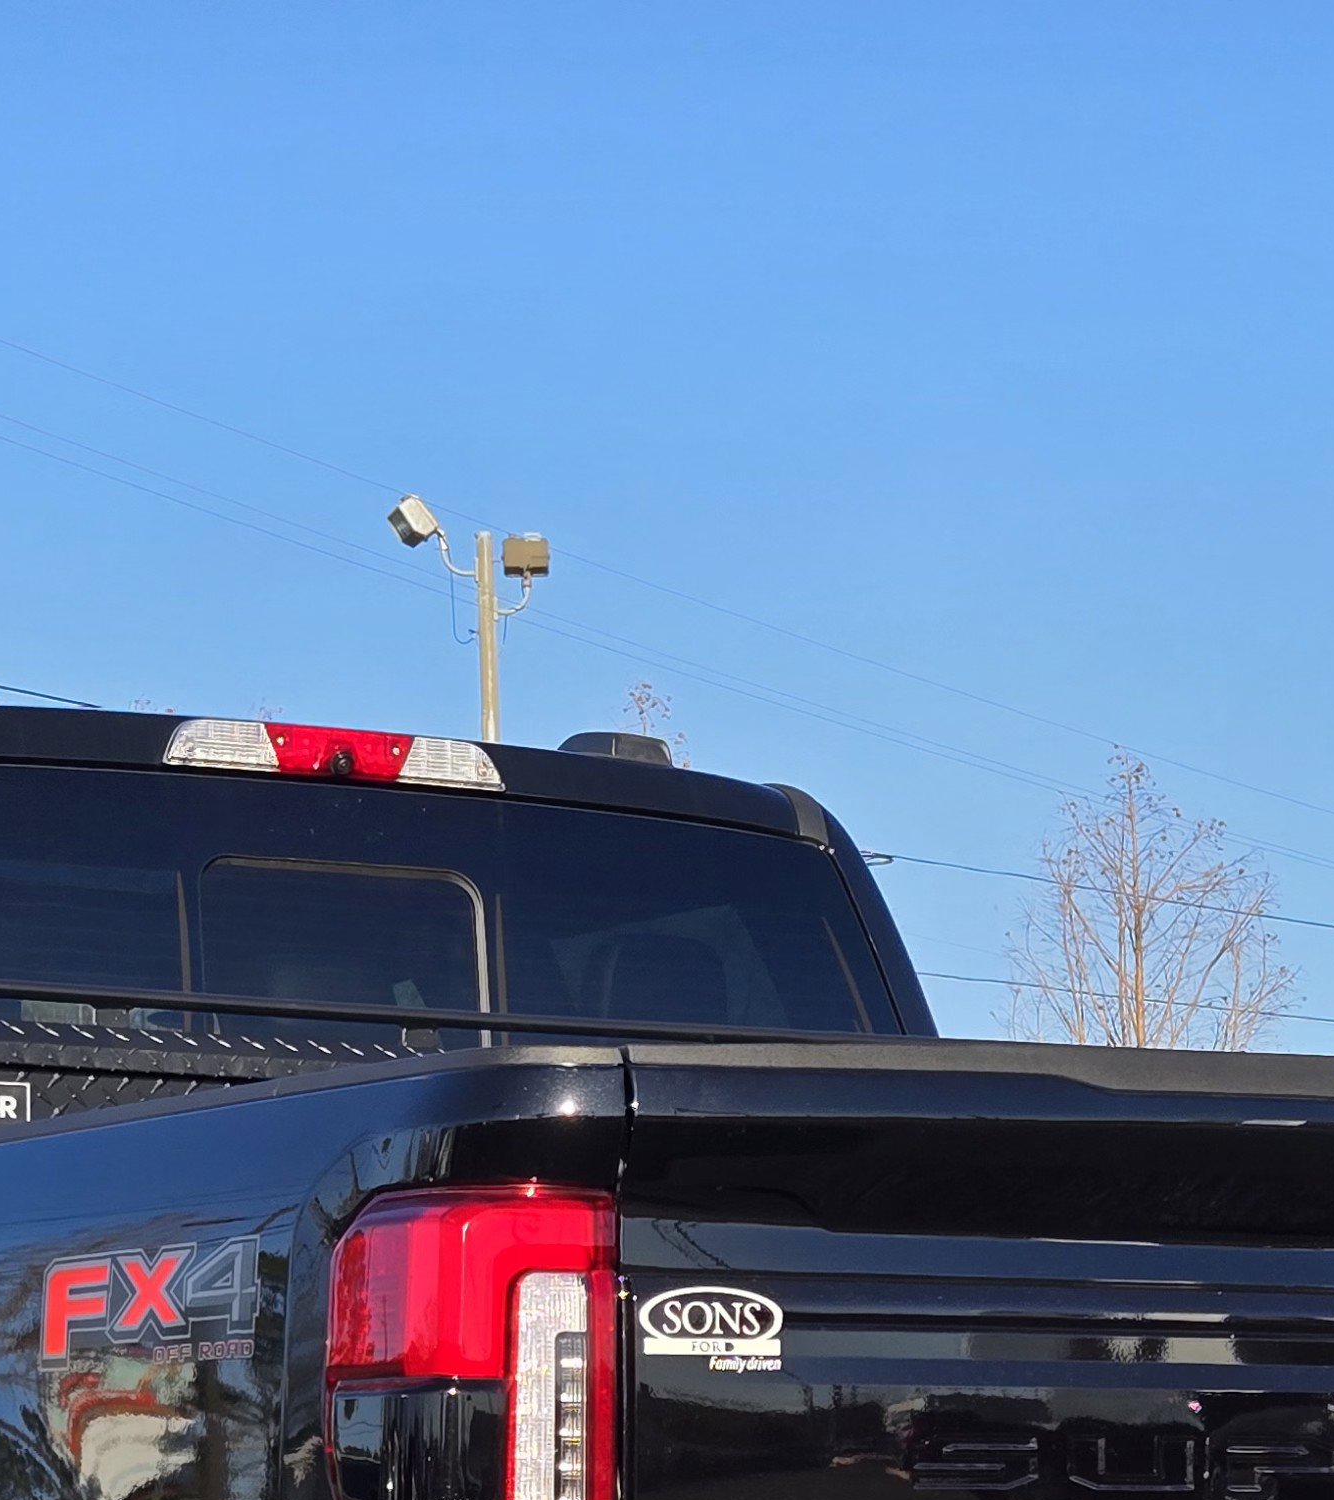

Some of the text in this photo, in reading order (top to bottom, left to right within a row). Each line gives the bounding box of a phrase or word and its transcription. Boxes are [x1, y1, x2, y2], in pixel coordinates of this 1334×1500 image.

[40, 1235, 260, 1370] FX4
[662, 1301, 761, 1335] SONS
[153, 1339, 255, 1365] OFF ROAD
[691, 1341, 735, 1352] FORD
